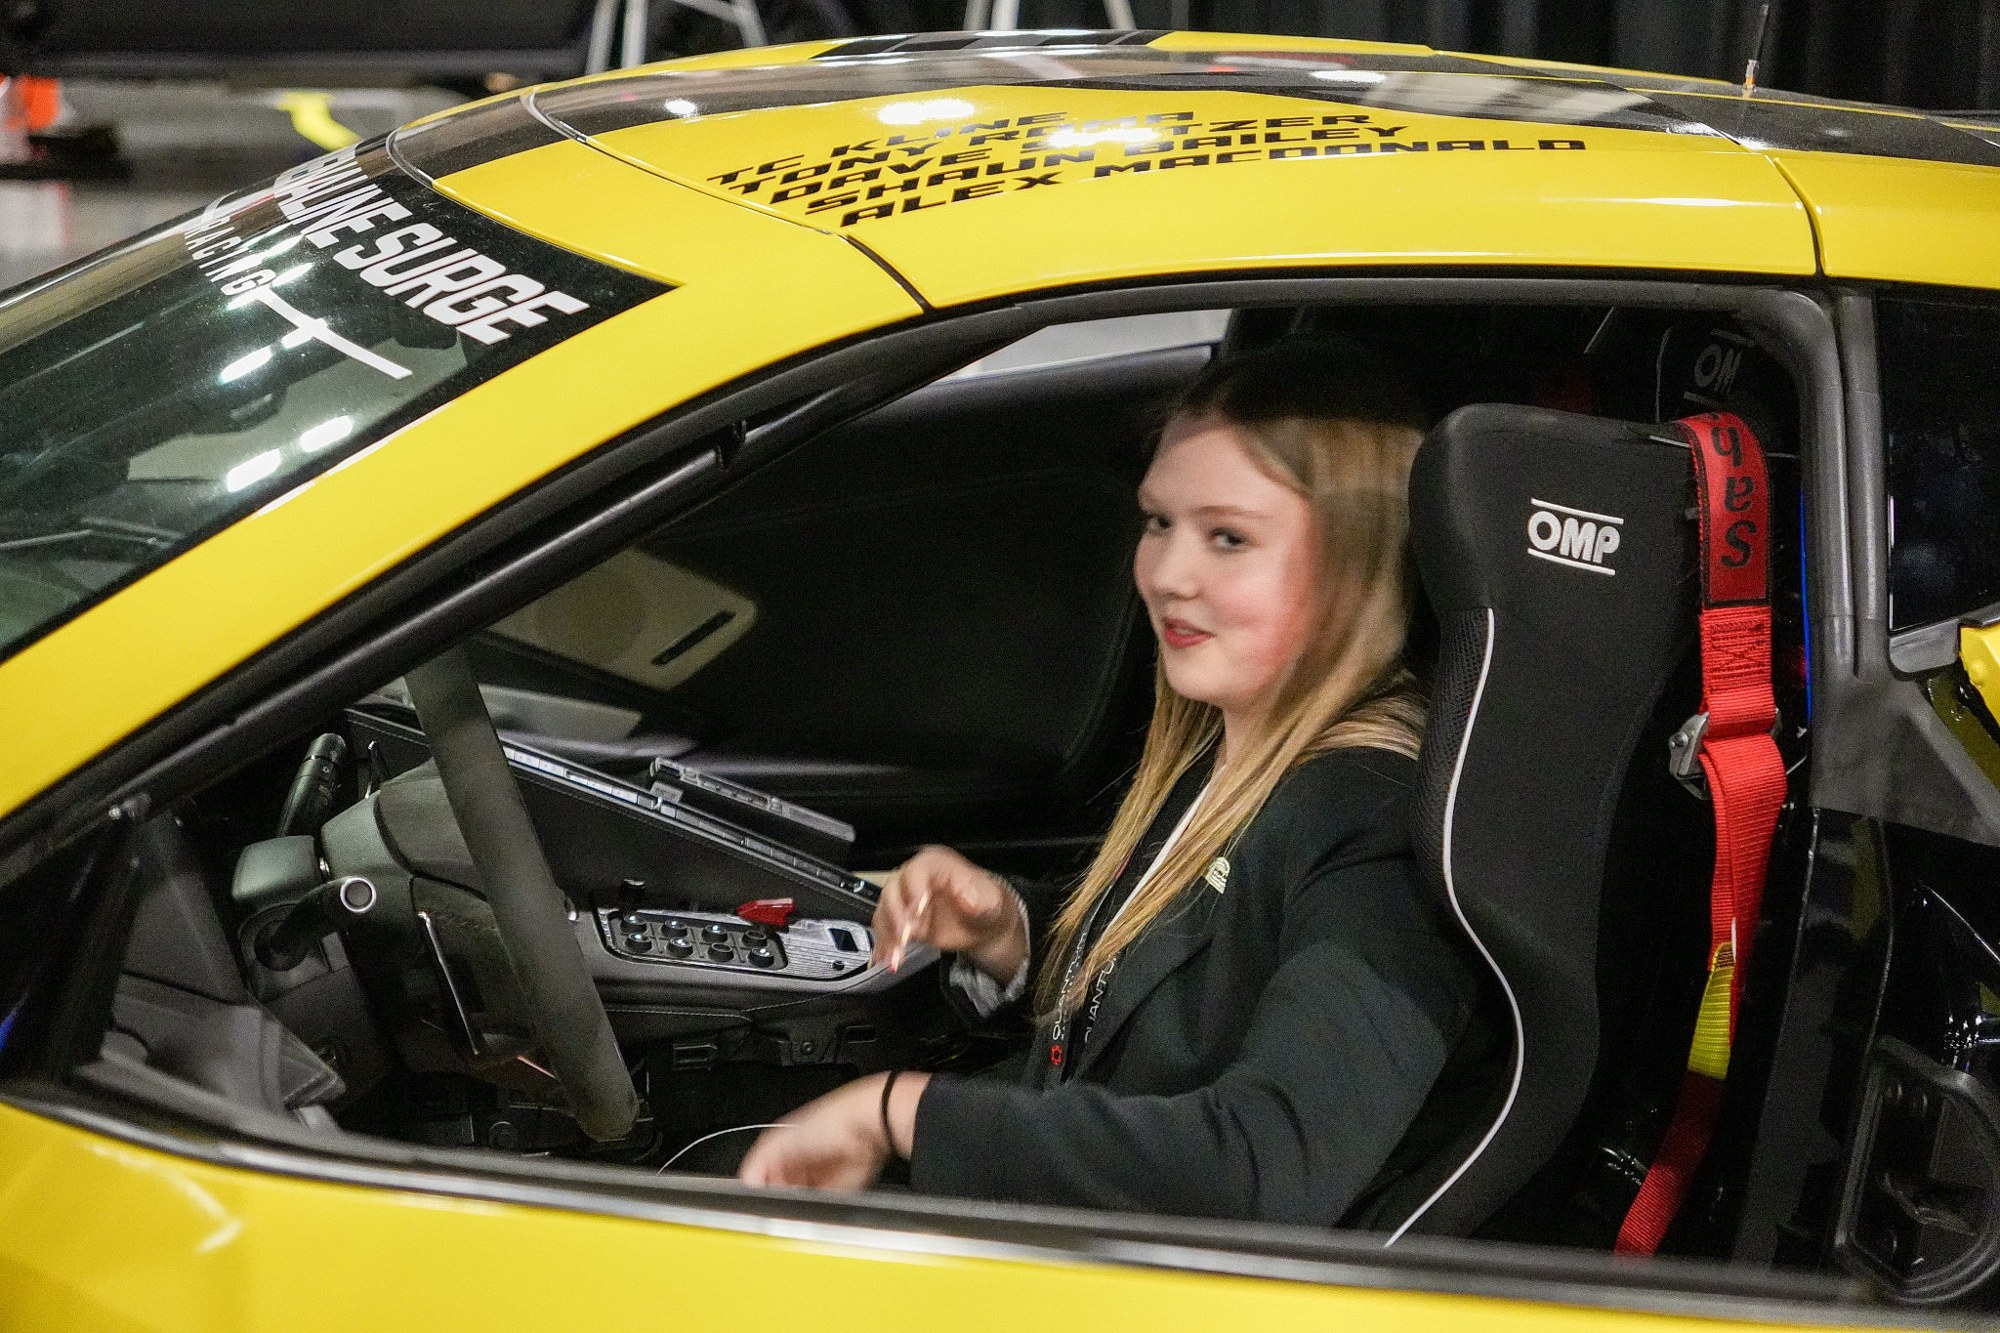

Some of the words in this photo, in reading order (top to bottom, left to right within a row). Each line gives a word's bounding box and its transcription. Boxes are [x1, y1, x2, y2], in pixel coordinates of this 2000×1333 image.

[706, 154, 806, 186] TC
[830, 111, 1068, 159] KLINE
[729, 143, 938, 195] TONY
[770, 148, 994, 205] DAVE
[804, 149, 1096, 216] SHAUN
[1124, 125, 1411, 157] BAILEY
[840, 172, 1065, 228] ALEX
[1093, 139, 1587, 178] MACDONALD
[185, 216, 277, 297] RACING
[333, 222, 590, 346] SURGE
[1527, 510, 1621, 564] OMP
